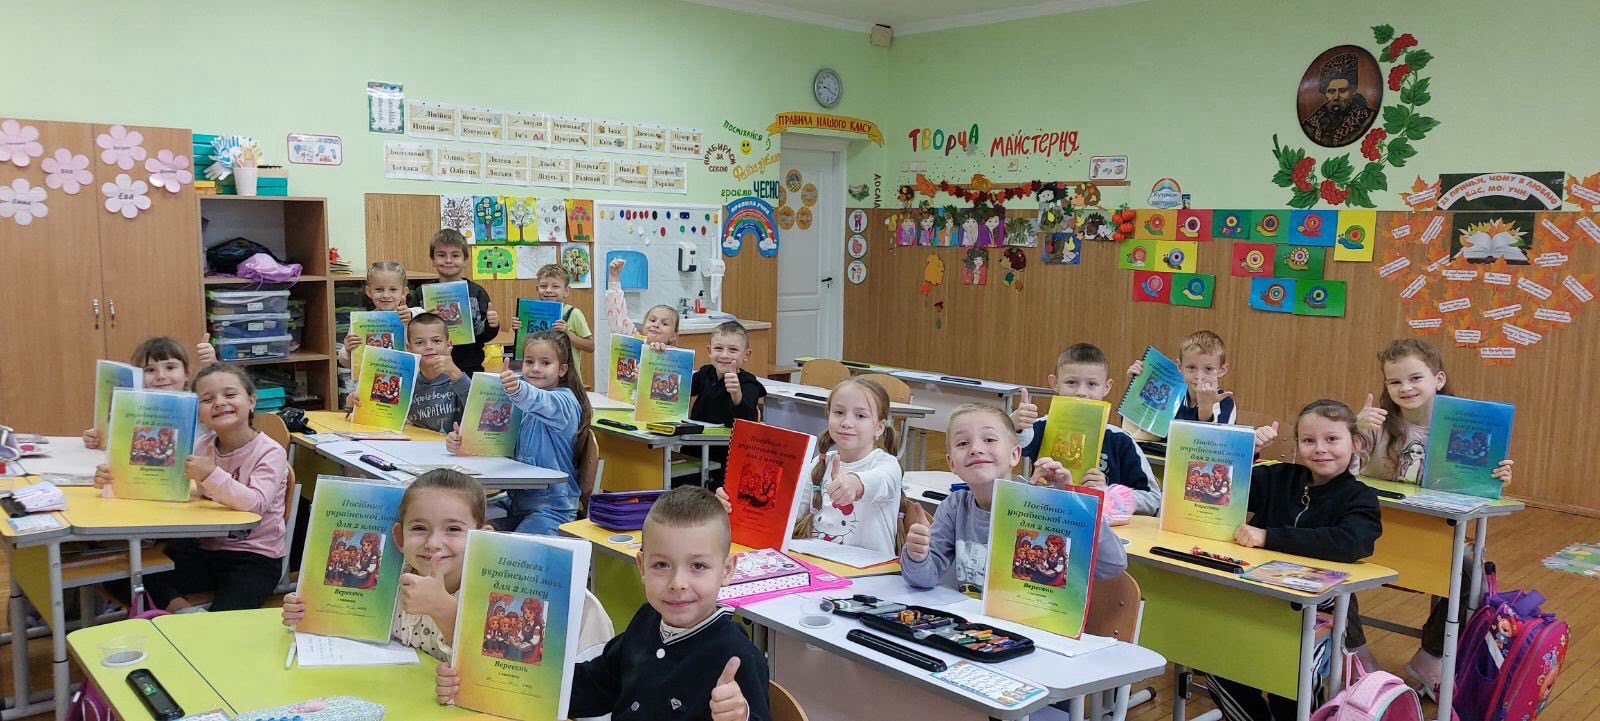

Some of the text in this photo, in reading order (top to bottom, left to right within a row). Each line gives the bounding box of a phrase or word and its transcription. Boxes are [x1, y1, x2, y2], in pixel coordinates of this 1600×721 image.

[724, 120, 762, 140] ПОСМІХАЙСЯ
[778, 115, 872, 134] ПРАВИЛА НАШОГО КЛАСУ
[908, 123, 1080, 157] ТВОРЧА МАЙСТЕРНЯ
[721, 180, 780, 202] граємо ЧЕСНО
[1526, 180, 1558, 205] ЛЮБЛЮ
[417, 403, 452, 420] УКРАЇНИ
[342, 500, 384, 510] Посібник
[1023, 500, 1066, 514] Посібник
[326, 510, 378, 522] української
[1008, 510, 1087, 528] української мови
[336, 520, 352, 528] для
[360, 524, 387, 532] класу
[1020, 520, 1036, 529] для
[1044, 525, 1072, 536] класу
[498, 556, 544, 572] Посібник
[481, 568, 539, 586] української
[334, 588, 364, 597] Вересень
[493, 581, 511, 592] для
[520, 586, 549, 600] класу
[1024, 582, 1054, 594] Вересень
[494, 660, 528, 672] Вересень
